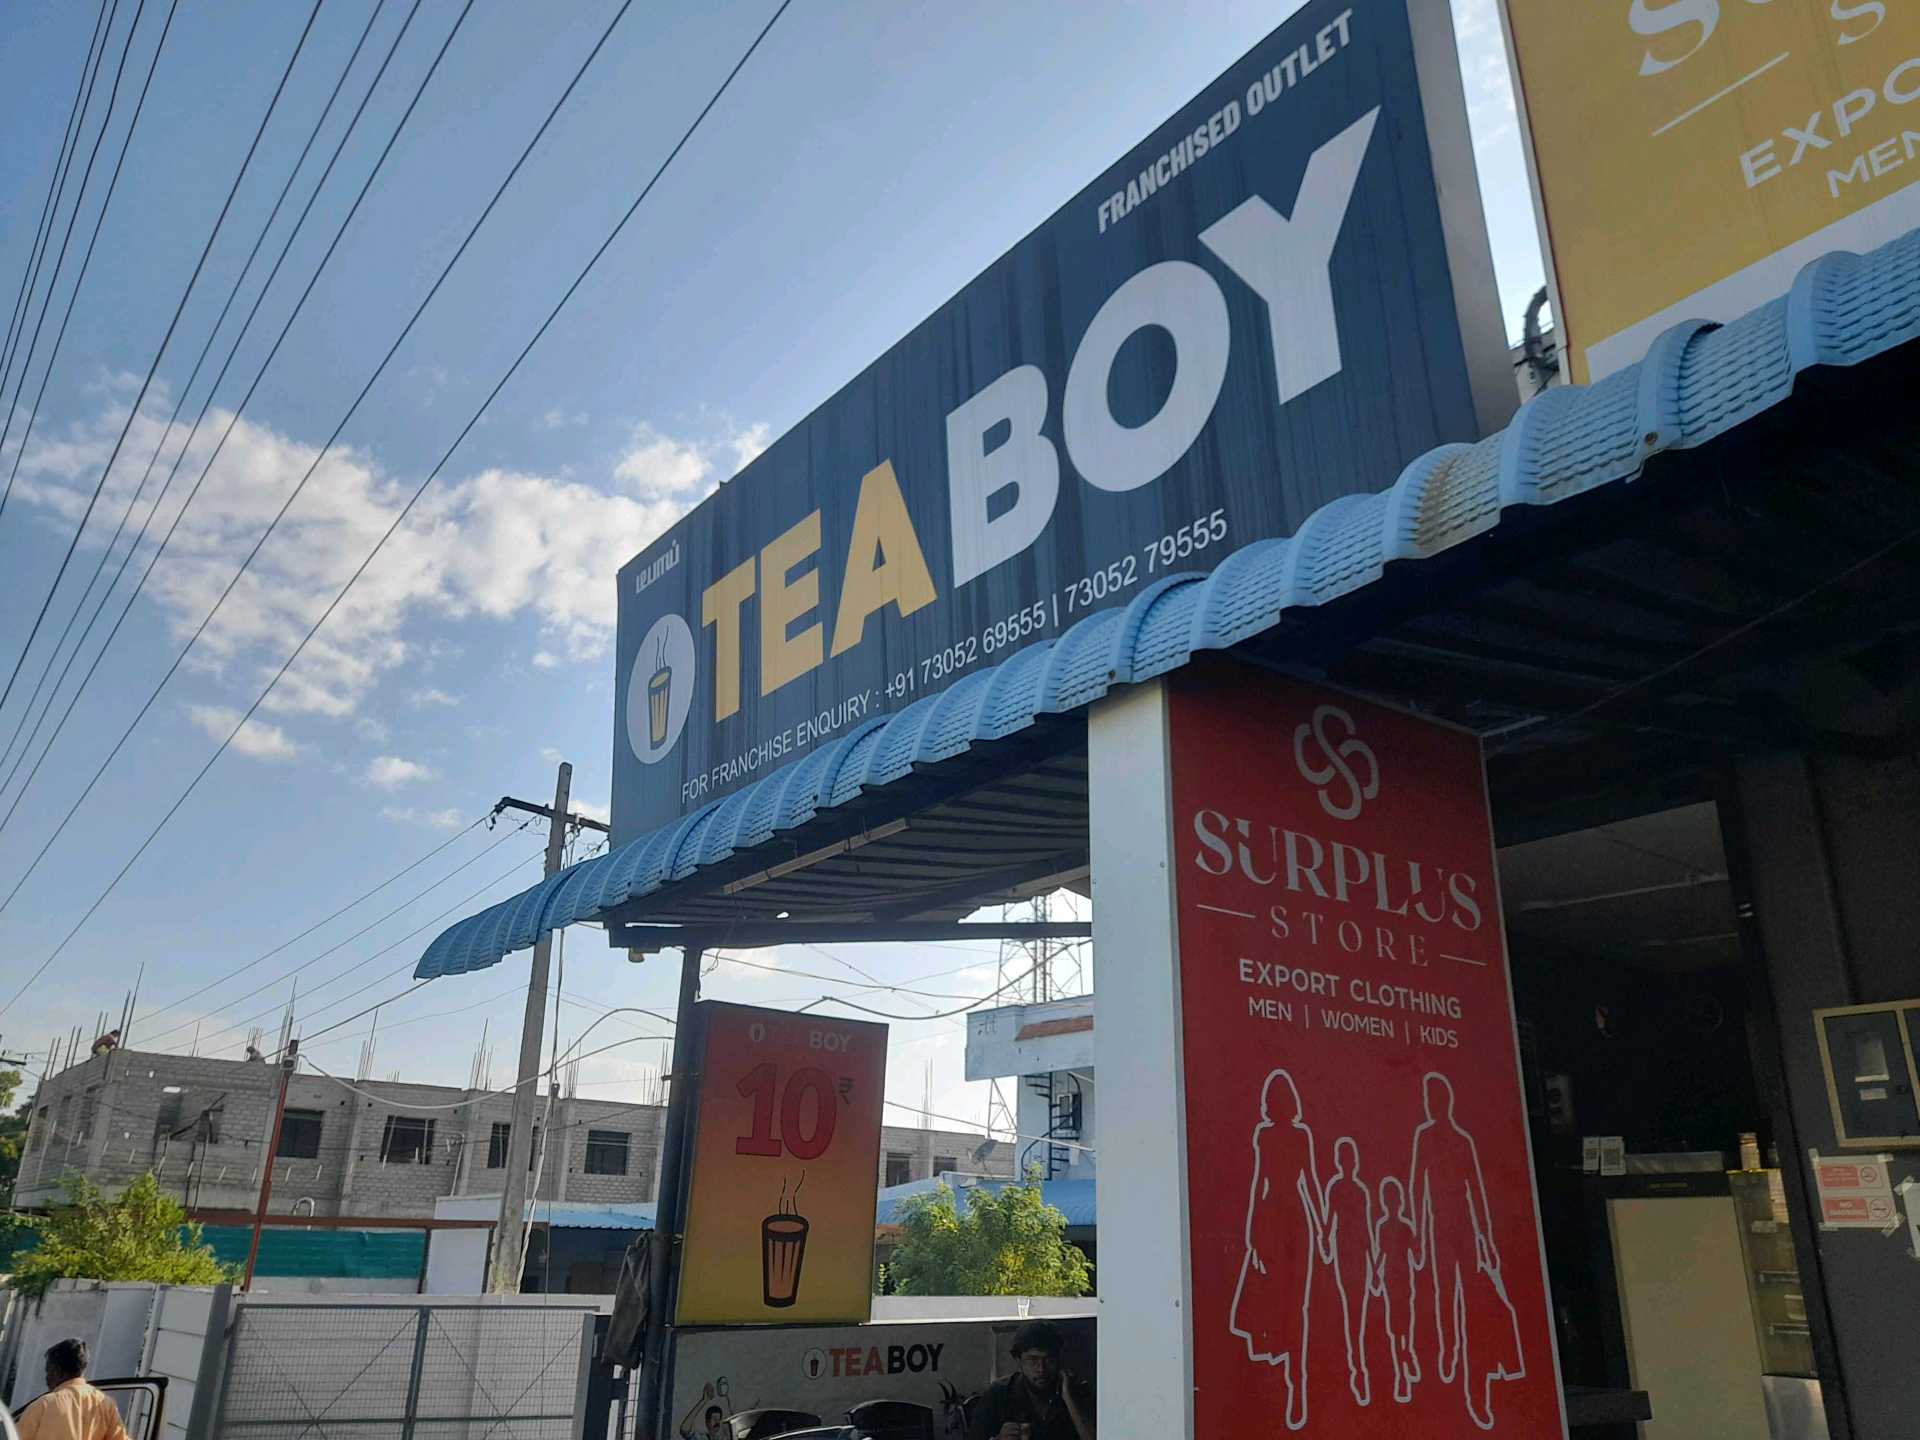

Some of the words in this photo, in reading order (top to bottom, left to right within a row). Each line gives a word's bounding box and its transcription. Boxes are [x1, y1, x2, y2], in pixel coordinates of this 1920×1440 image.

[1098, 100, 1242, 235] FRANCHISED
[1246, 8, 1353, 117] OUTLET
[702, 458, 938, 723] TEA
[946, 104, 1381, 589] BOY
[682, 774, 709, 804] FOR
[711, 730, 793, 792] FRANCHISE
[884, 669, 915, 699] +91
[921, 636, 978, 685] 73052
[983, 600, 1047, 655] 69555
[1064, 555, 1138, 613] 73052
[1144, 508, 1228, 574] 79555
[1193, 808, 1482, 932] SURPLUS
[1270, 905, 1429, 967] STORE
[1239, 958, 1341, 998] EXPORT
[1350, 978, 1463, 1019] CLOTHING
[808, 1030, 854, 1054] BOY
[1248, 996, 1292, 1022] MEN
[1321, 1008, 1395, 1039] WOMEN
[1419, 1025, 1459, 1049] KIDS
[828, 1346, 889, 1378] TEA
[887, 1343, 945, 1375] BOY
